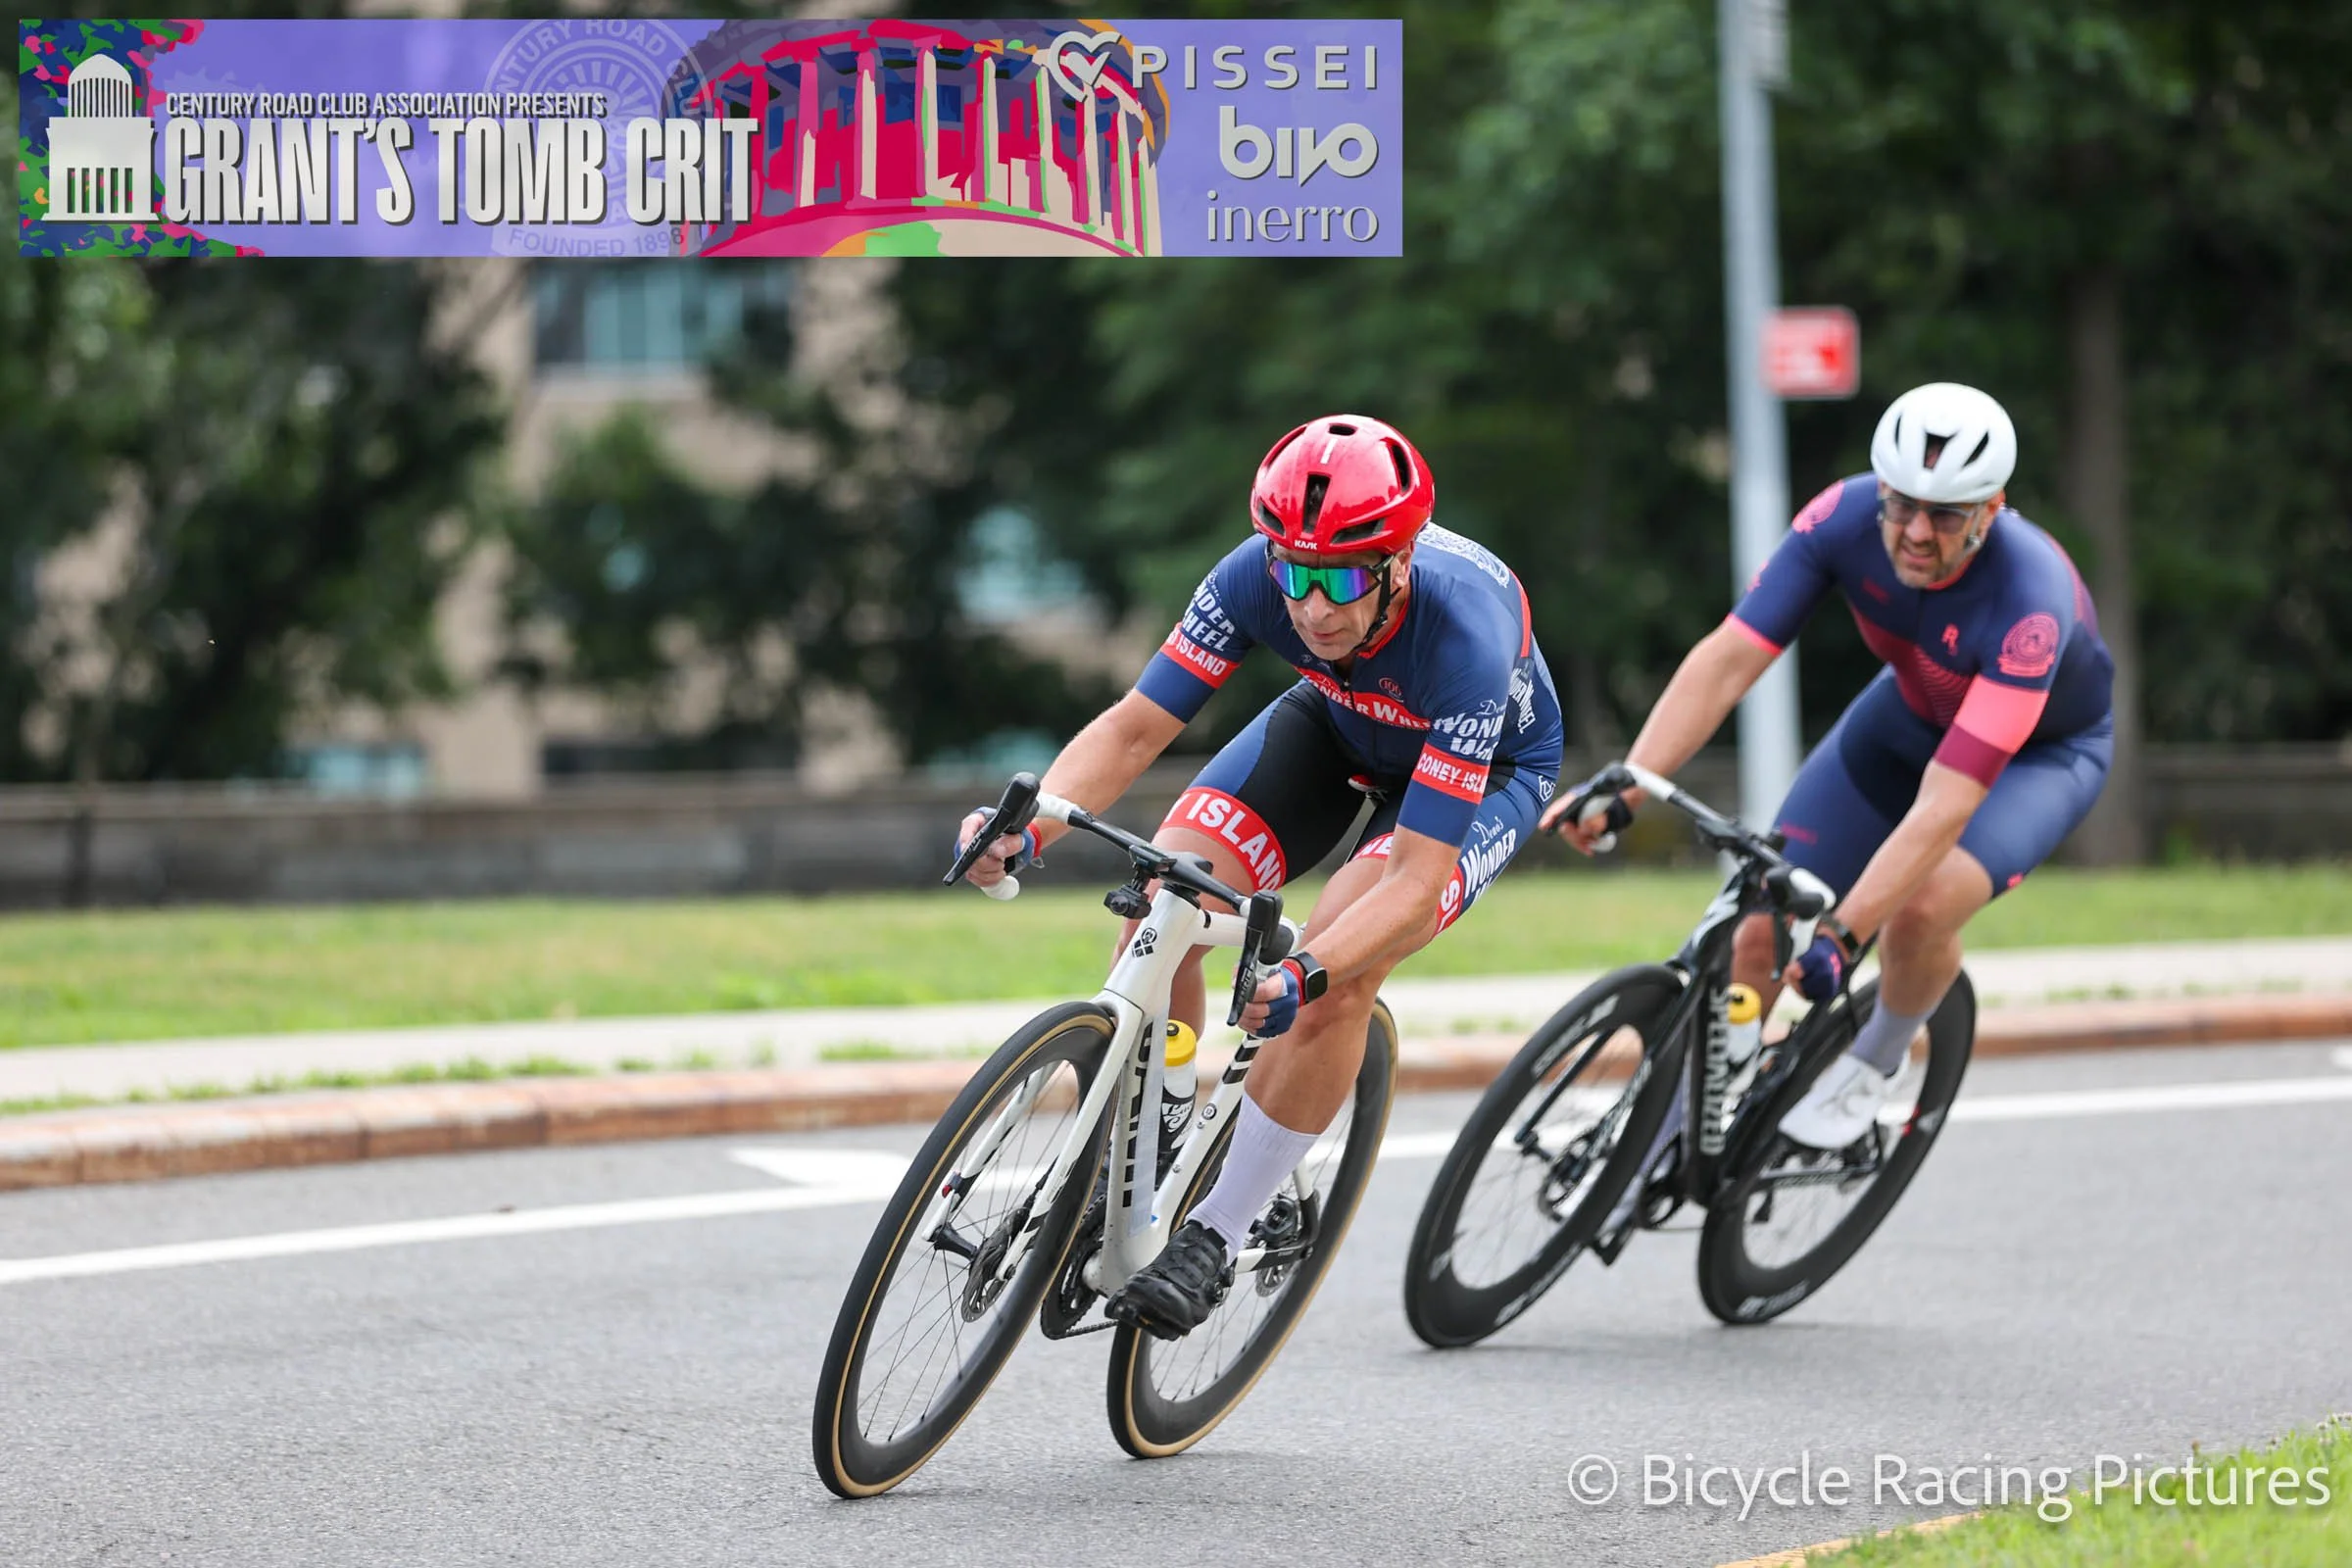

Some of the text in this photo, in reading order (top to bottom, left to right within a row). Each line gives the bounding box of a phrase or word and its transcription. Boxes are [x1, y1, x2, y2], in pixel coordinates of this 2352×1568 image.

[1295, 539, 1318, 551] KASK
[1182, 600, 1231, 652] HEEL
[1176, 635, 1228, 676] ISLAND
[1433, 712, 1504, 739] WOND
[1417, 753, 1461, 785] CONEY
[1460, 828, 1517, 900] WONDER
